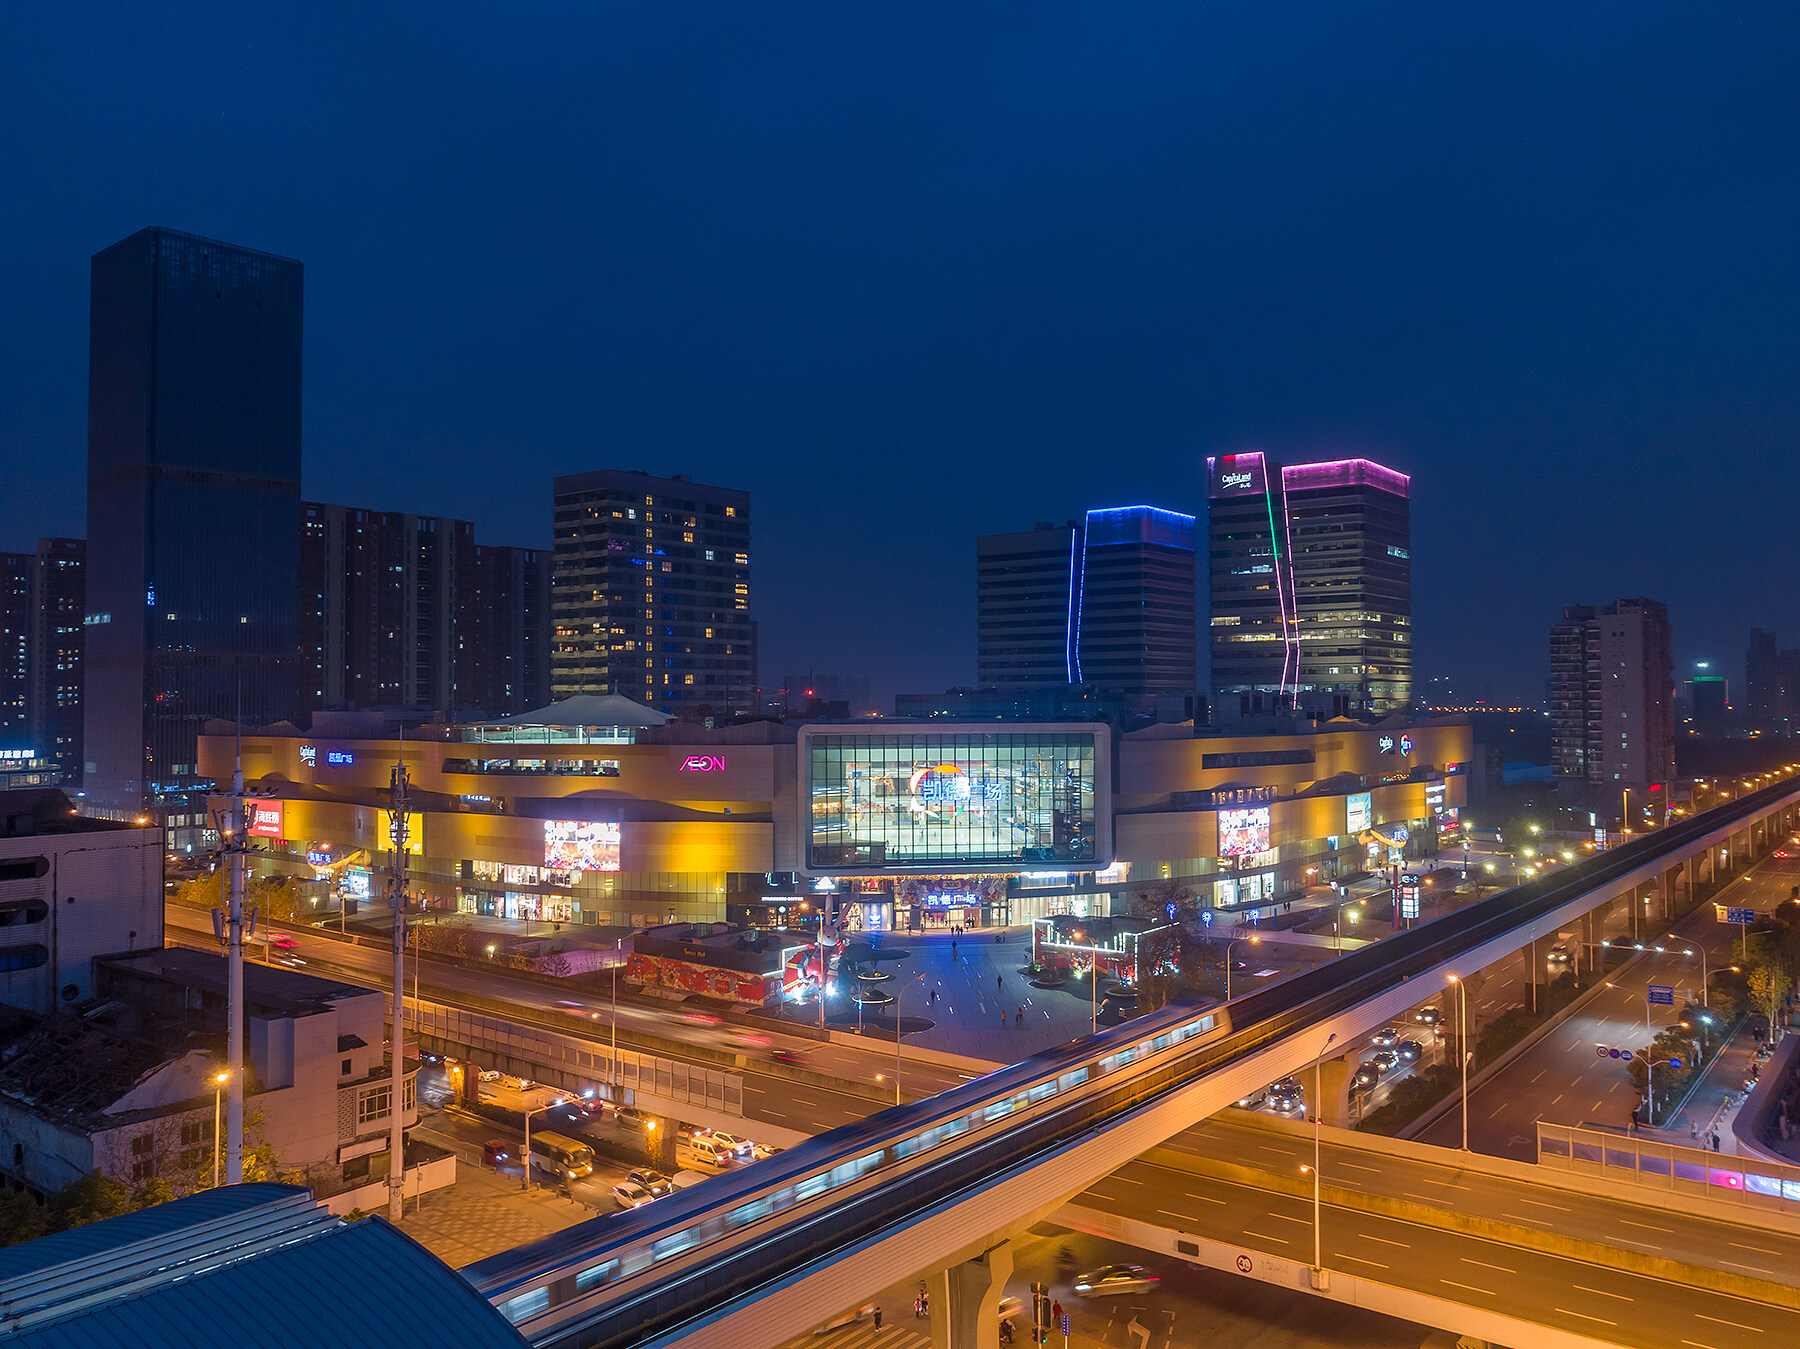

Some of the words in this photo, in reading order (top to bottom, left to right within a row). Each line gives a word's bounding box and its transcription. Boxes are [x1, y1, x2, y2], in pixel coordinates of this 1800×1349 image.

[922, 777, 1002, 802] 凯德广场
[927, 891, 976, 905] 凯德广场
